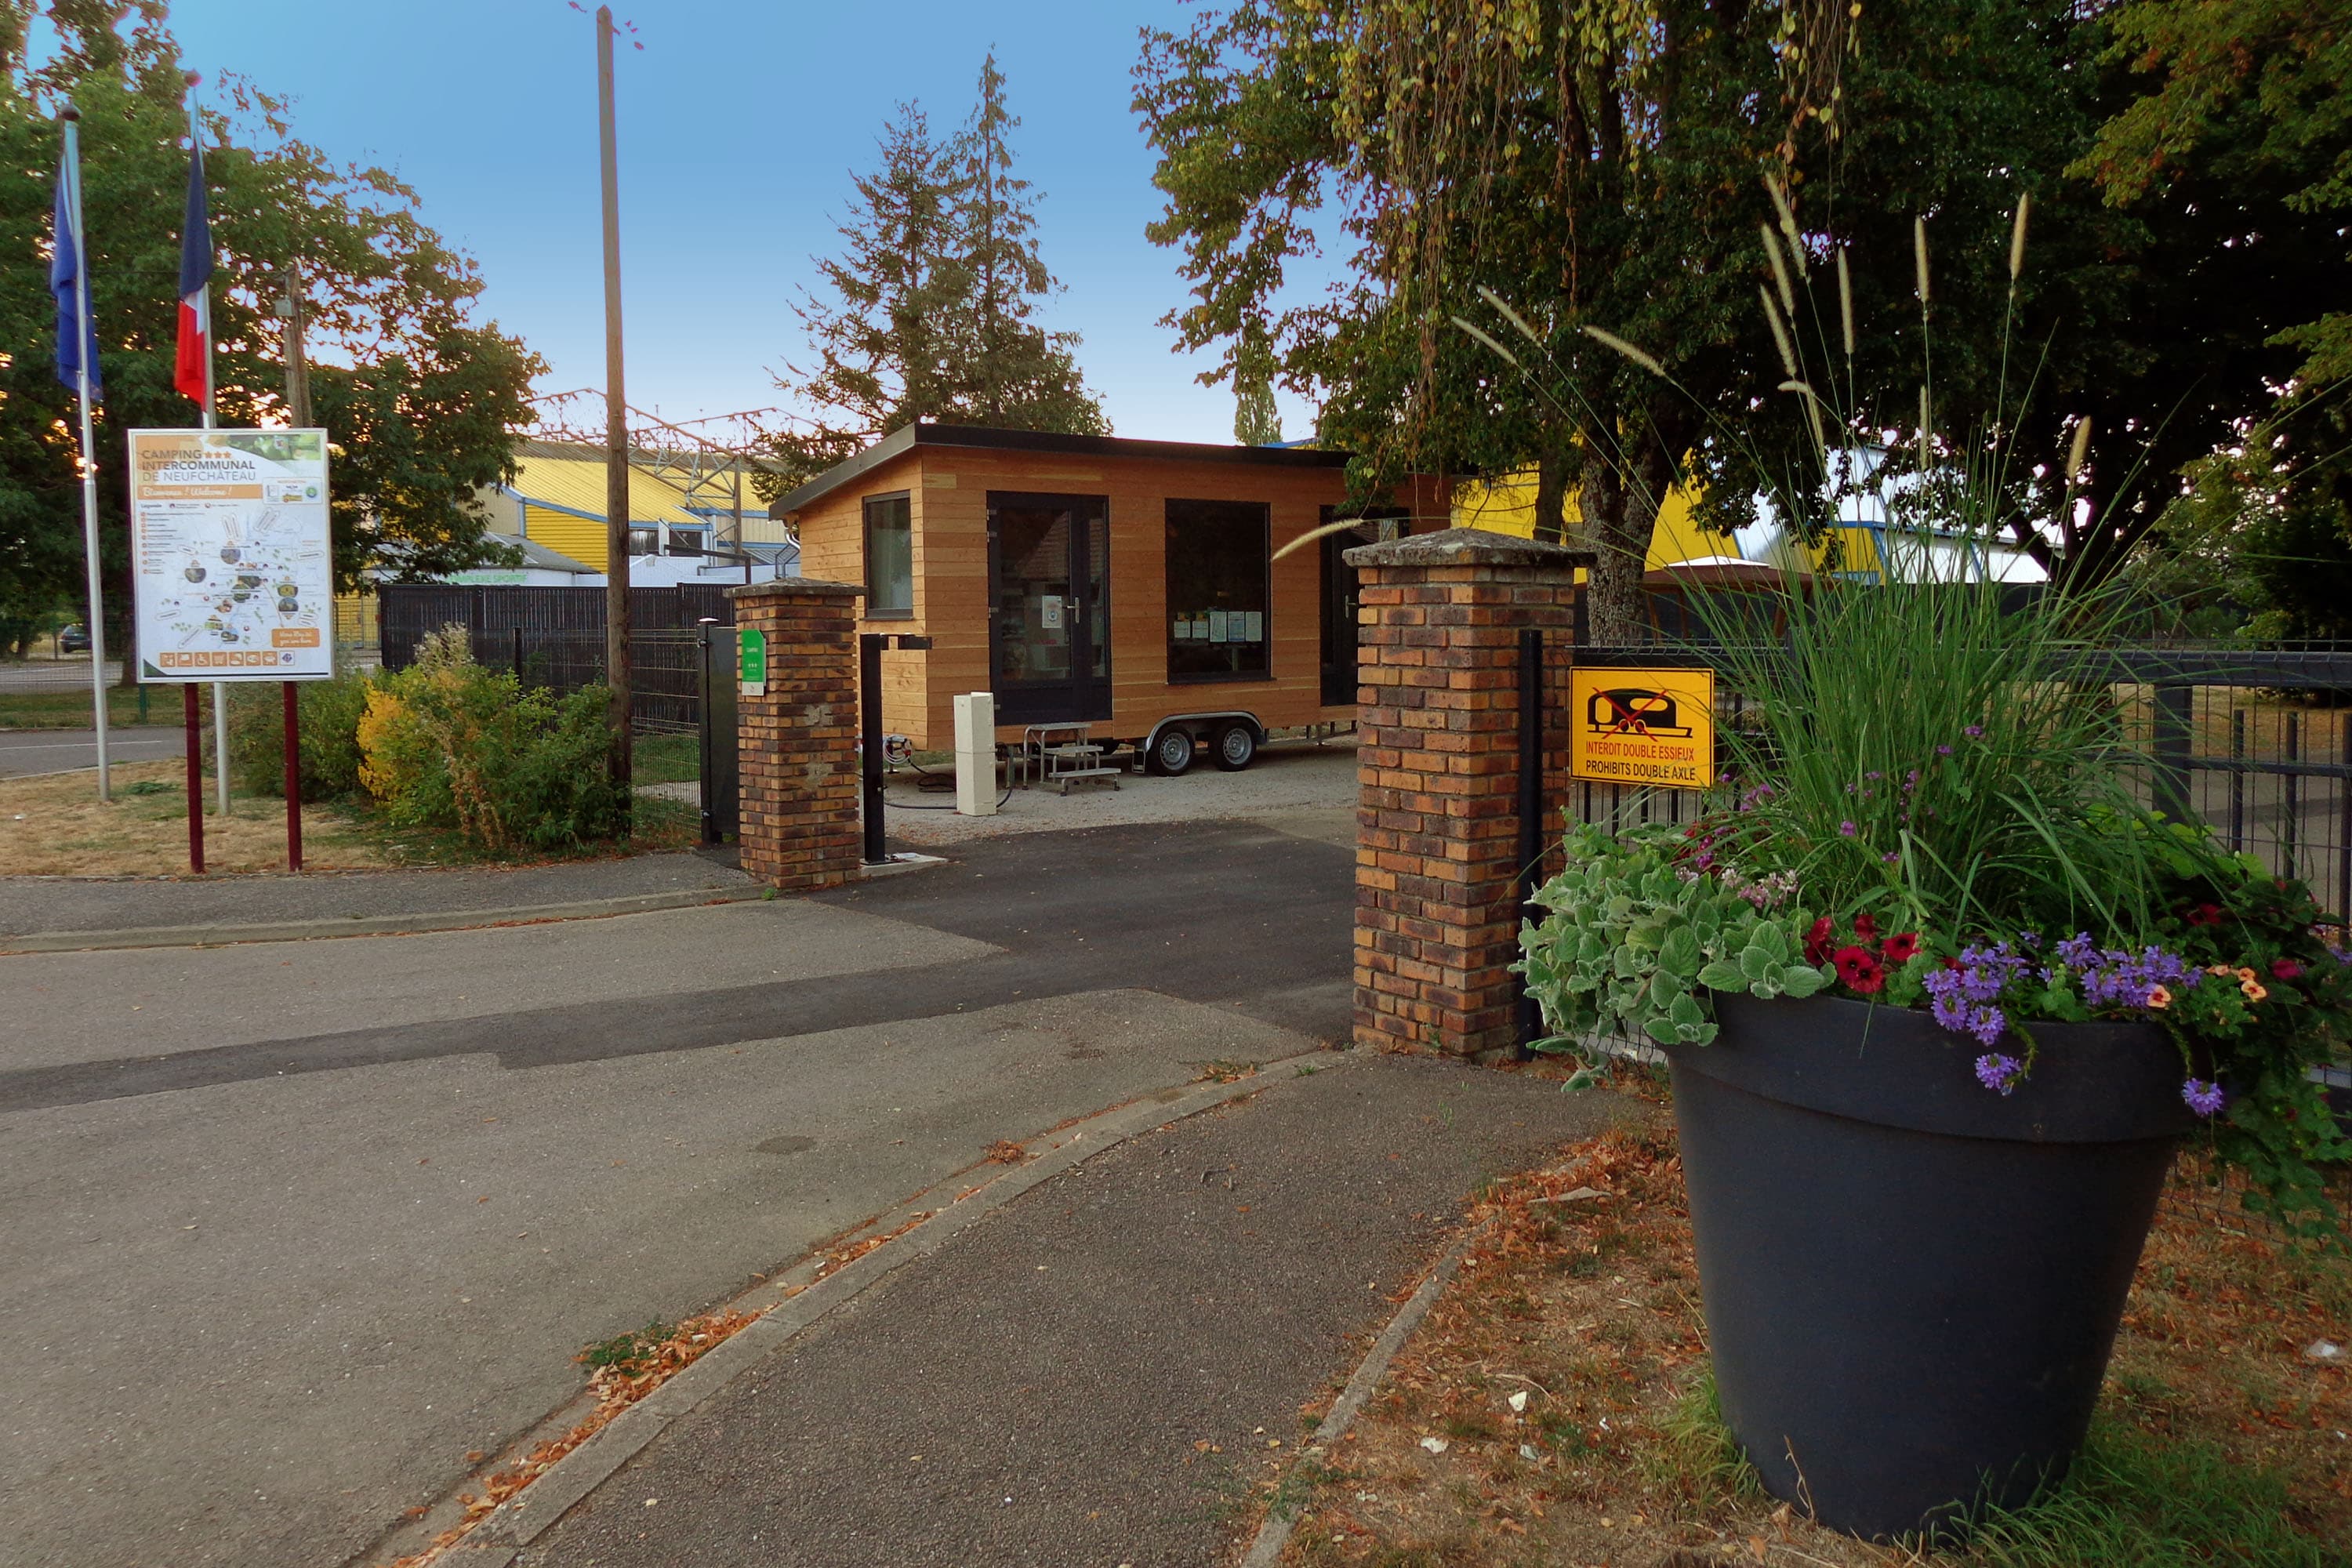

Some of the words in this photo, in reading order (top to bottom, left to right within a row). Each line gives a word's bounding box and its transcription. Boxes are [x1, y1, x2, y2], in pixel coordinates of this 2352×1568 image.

[142, 450, 201, 459] CAMPING
[142, 460, 256, 470] INTERCOMMUNAL
[143, 472, 159, 481] DE
[1586, 740, 1621, 756] INTERDIT
[1624, 744, 1657, 758] DOUBLE
[1659, 746, 1694, 761] ESSIEUX
[1586, 760, 1631, 775] PROHIBITS
[1633, 764, 1669, 778] DOUBLE
[1671, 766, 1696, 781] AXLE
